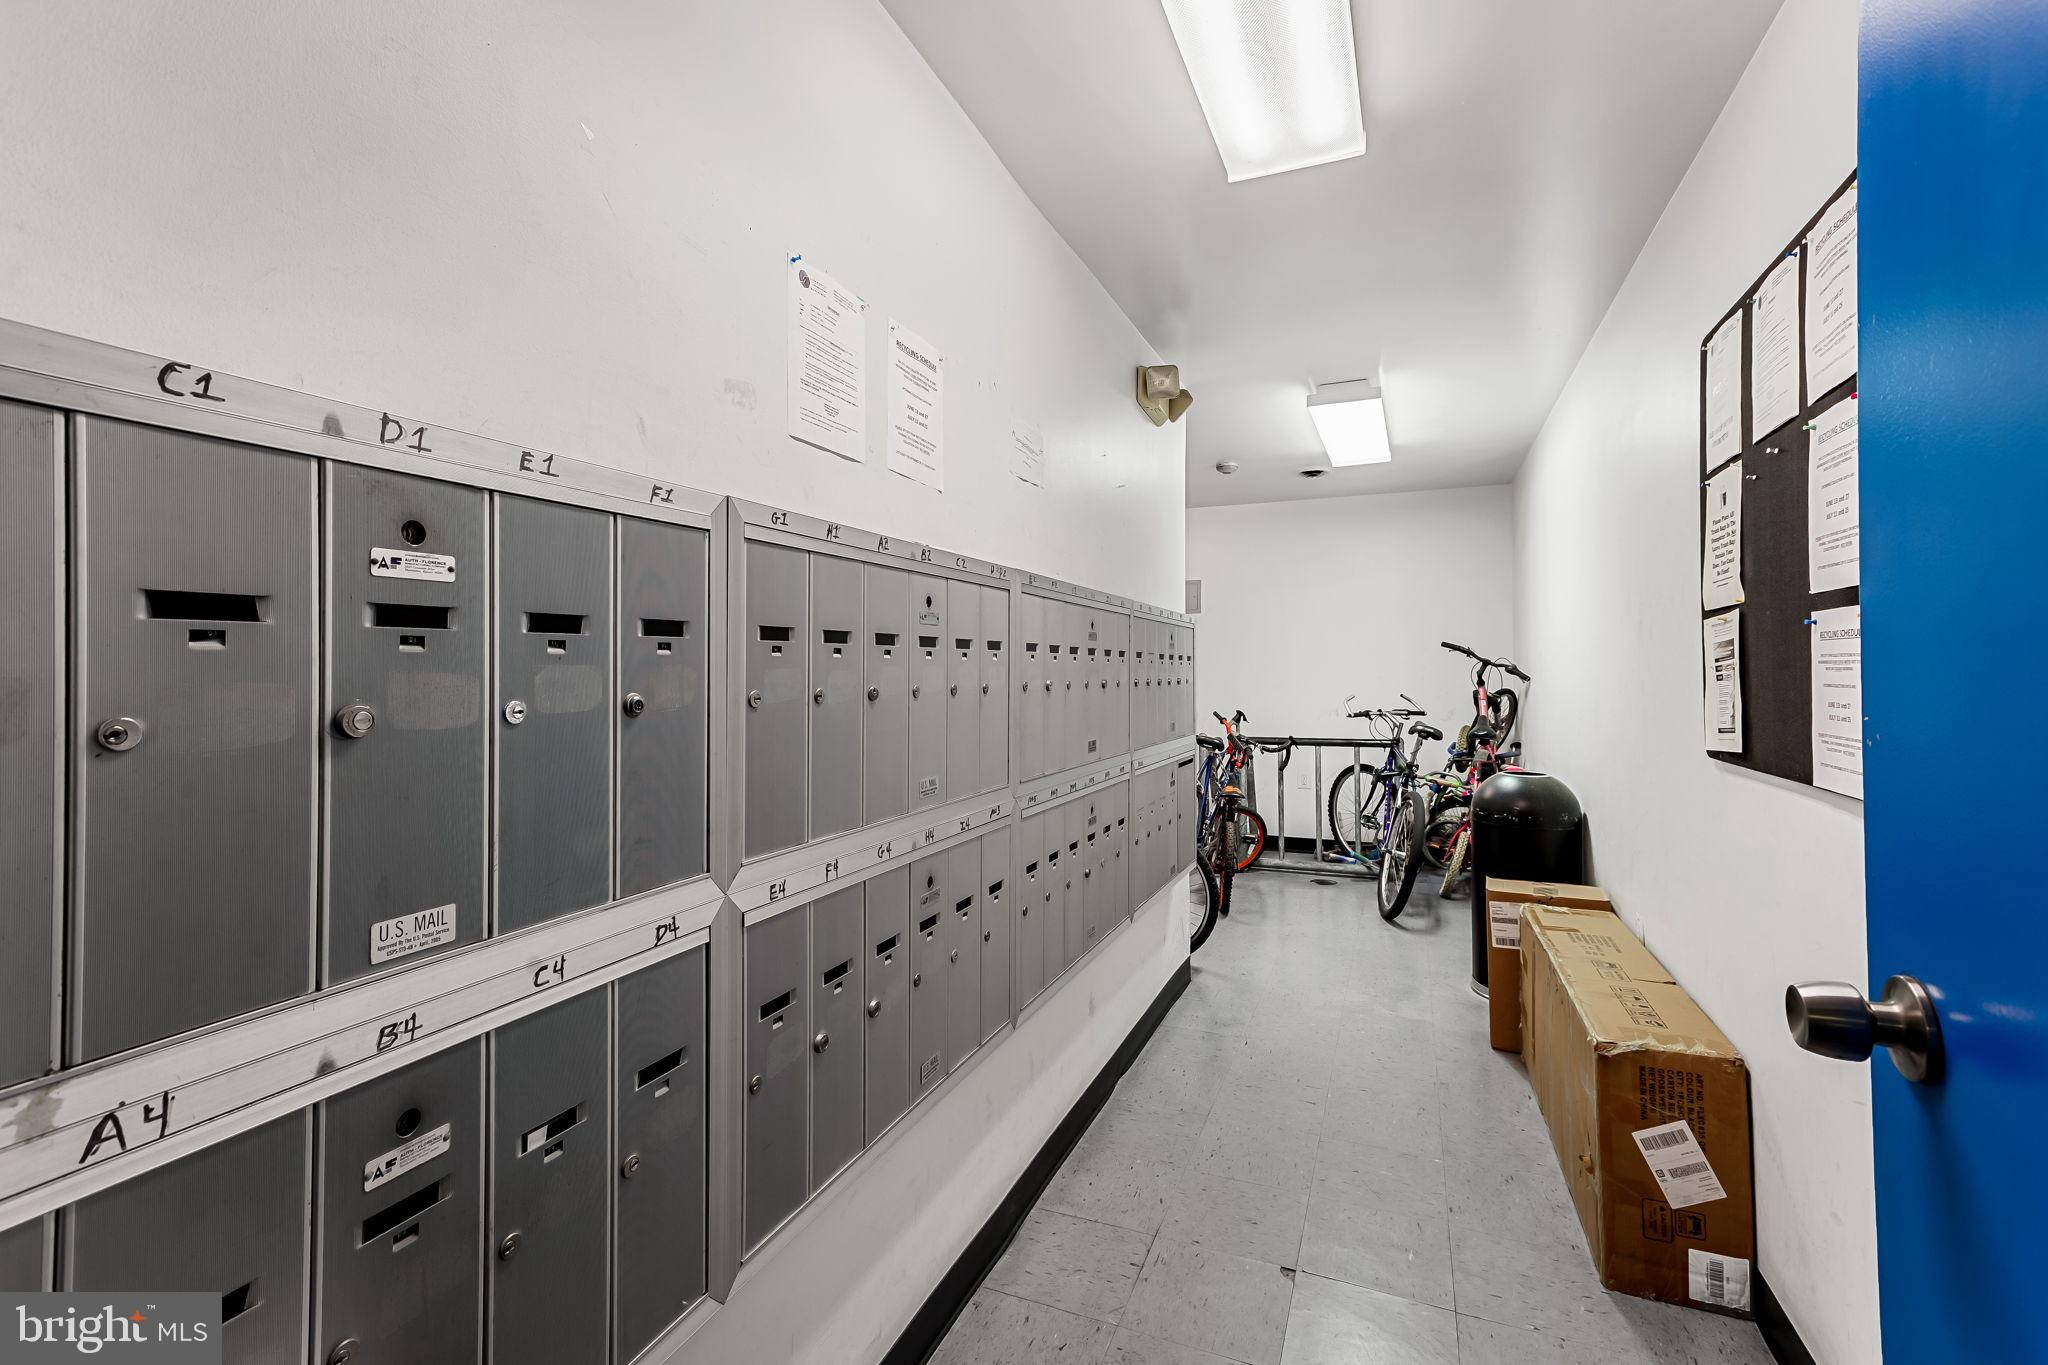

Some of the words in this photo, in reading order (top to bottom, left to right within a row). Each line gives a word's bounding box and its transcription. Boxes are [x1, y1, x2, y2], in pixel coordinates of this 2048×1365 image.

[157, 362, 226, 402] C1
[380, 412, 432, 453] D1
[519, 450, 559, 478] E1
[650, 484, 675, 504] F1
[771, 512, 789, 527] G1
[825, 858, 839, 882] F4
[769, 879, 787, 901] E4
[380, 920, 408, 942] U.S.
[414, 909, 448, 933] MAIL
[654, 917, 681, 947] D4
[533, 954, 567, 988] C4
[375, 1012, 424, 1052] B4
[79, 1090, 175, 1164] A4
